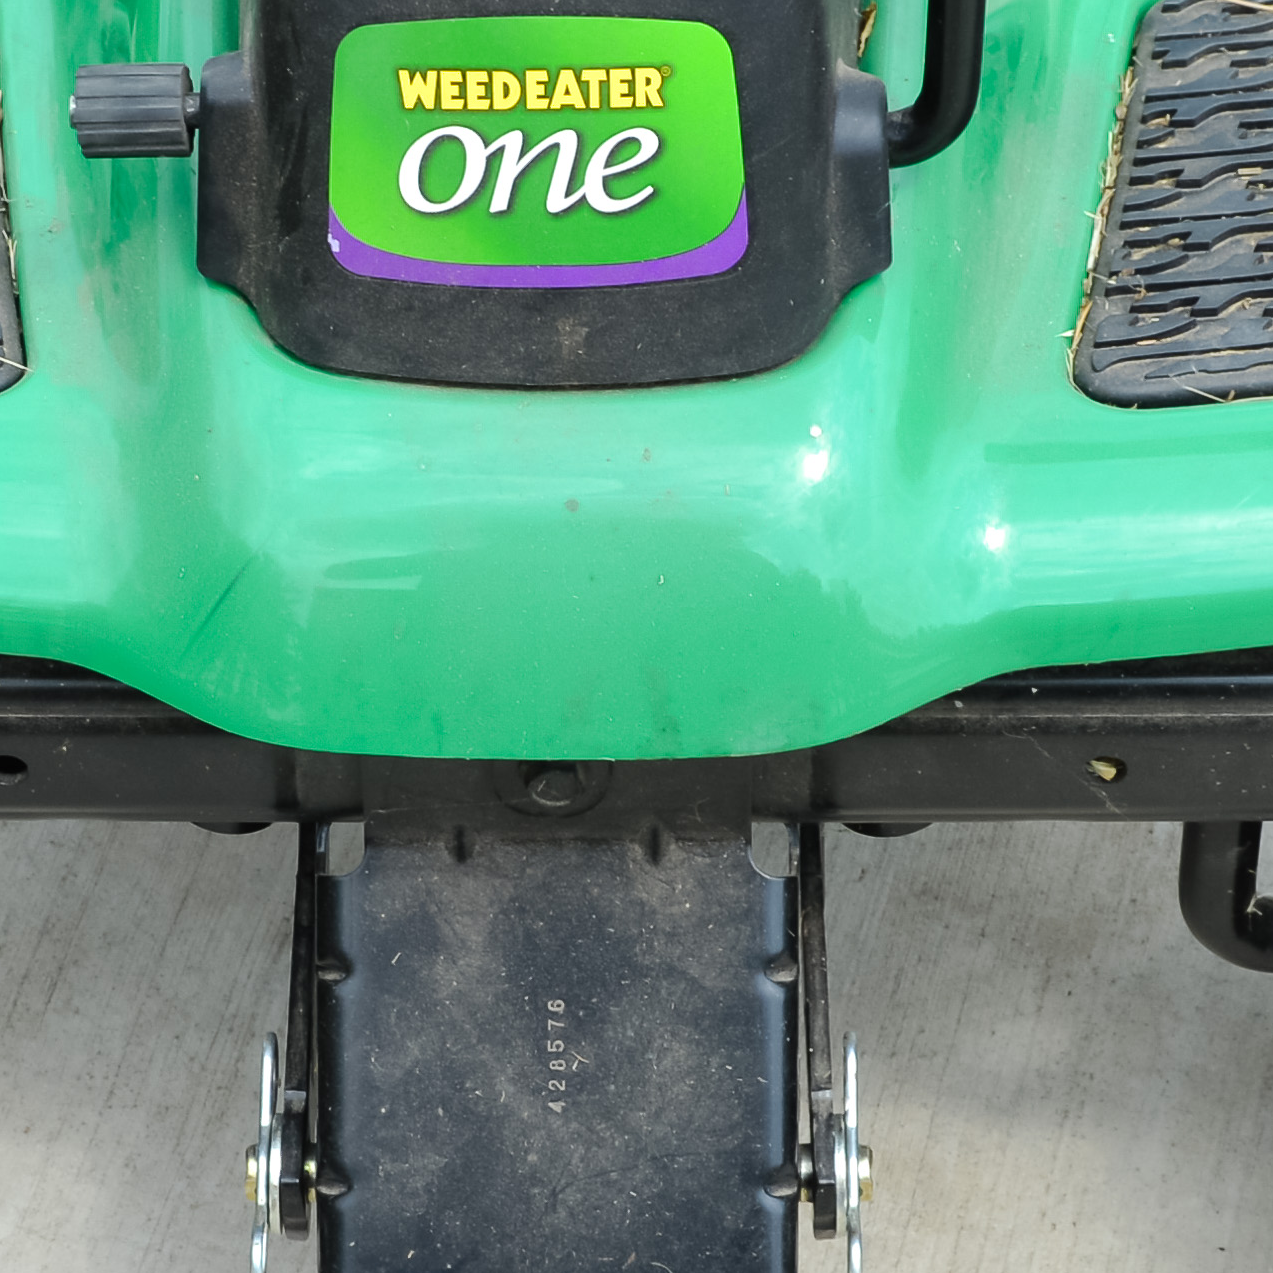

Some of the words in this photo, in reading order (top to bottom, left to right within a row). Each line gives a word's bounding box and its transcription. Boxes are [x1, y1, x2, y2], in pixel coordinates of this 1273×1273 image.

[398, 67, 664, 110] WEEDEATER
[398, 125, 660, 214] one
[547, 999, 567, 1113] 428576
